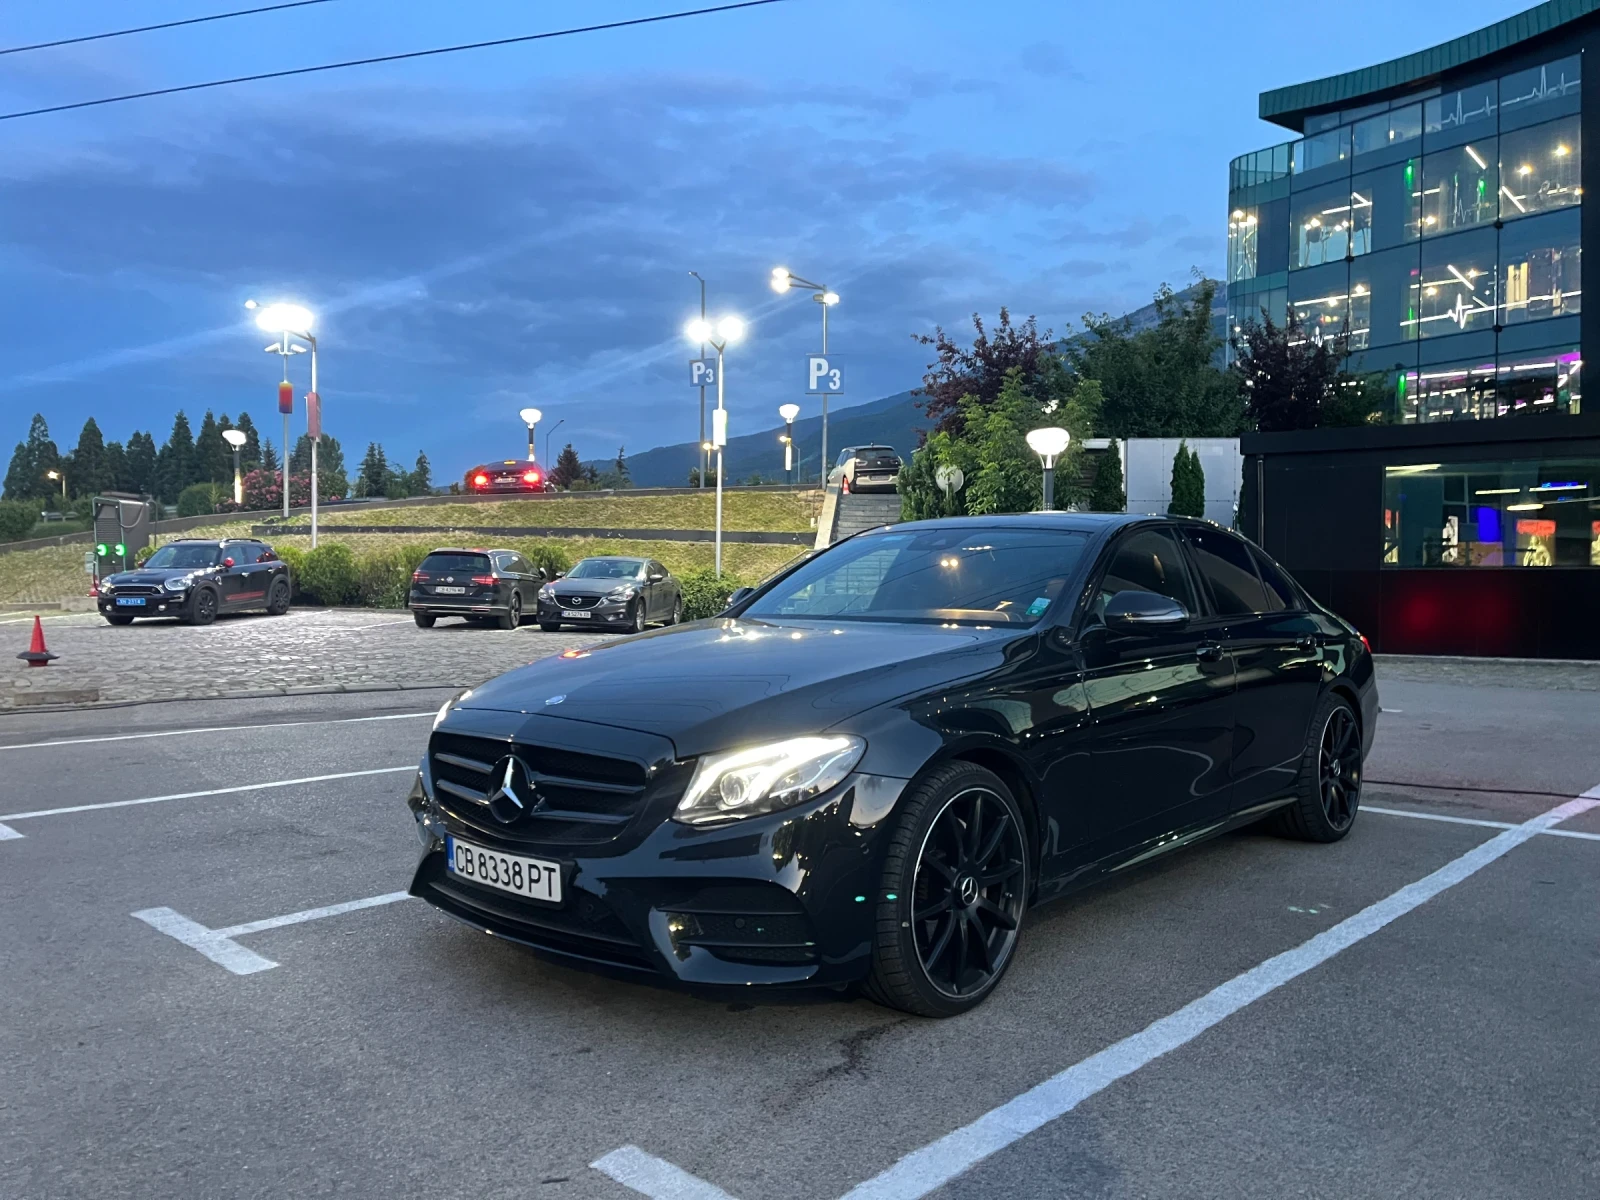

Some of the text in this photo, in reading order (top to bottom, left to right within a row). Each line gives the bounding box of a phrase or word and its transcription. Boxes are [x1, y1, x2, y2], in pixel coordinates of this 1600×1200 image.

[692, 362, 714, 384] P3
[809, 357, 841, 390] P3
[455, 844, 557, 898] CB 8338 PT
